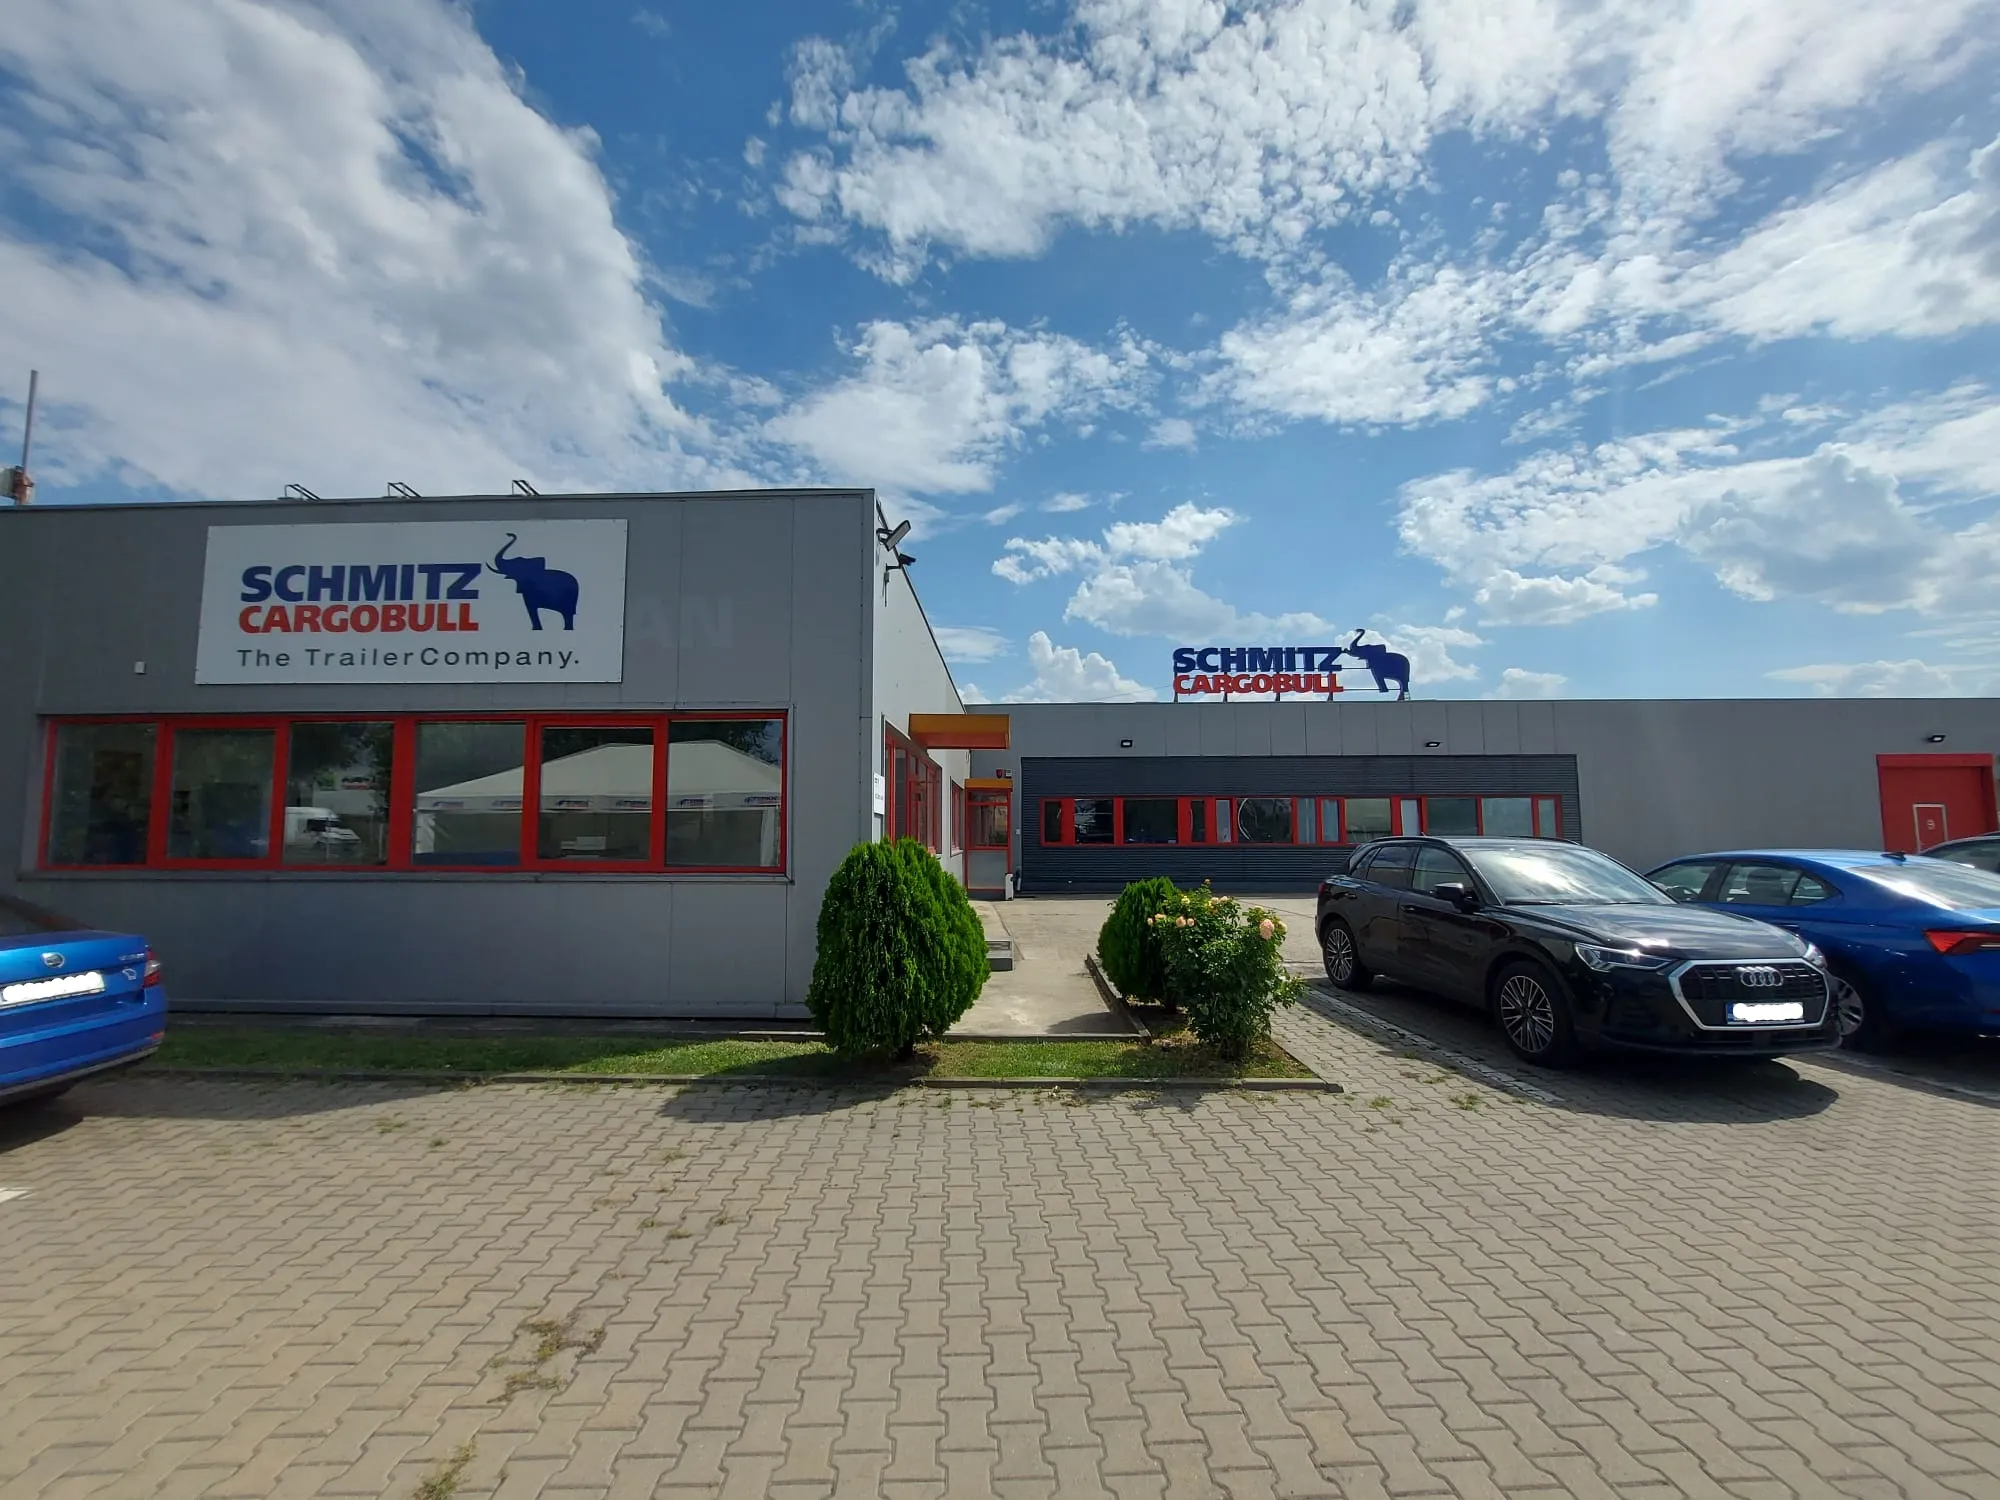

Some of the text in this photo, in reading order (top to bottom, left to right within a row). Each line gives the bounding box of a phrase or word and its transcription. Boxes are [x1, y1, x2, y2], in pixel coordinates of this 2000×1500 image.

[240, 562, 482, 602] SCHMITZ
[238, 602, 479, 634] CARGOBULL
[236, 648, 291, 668] The
[1173, 646, 1342, 673] SCHMITZ
[1173, 673, 1344, 694] CARGOBULL
